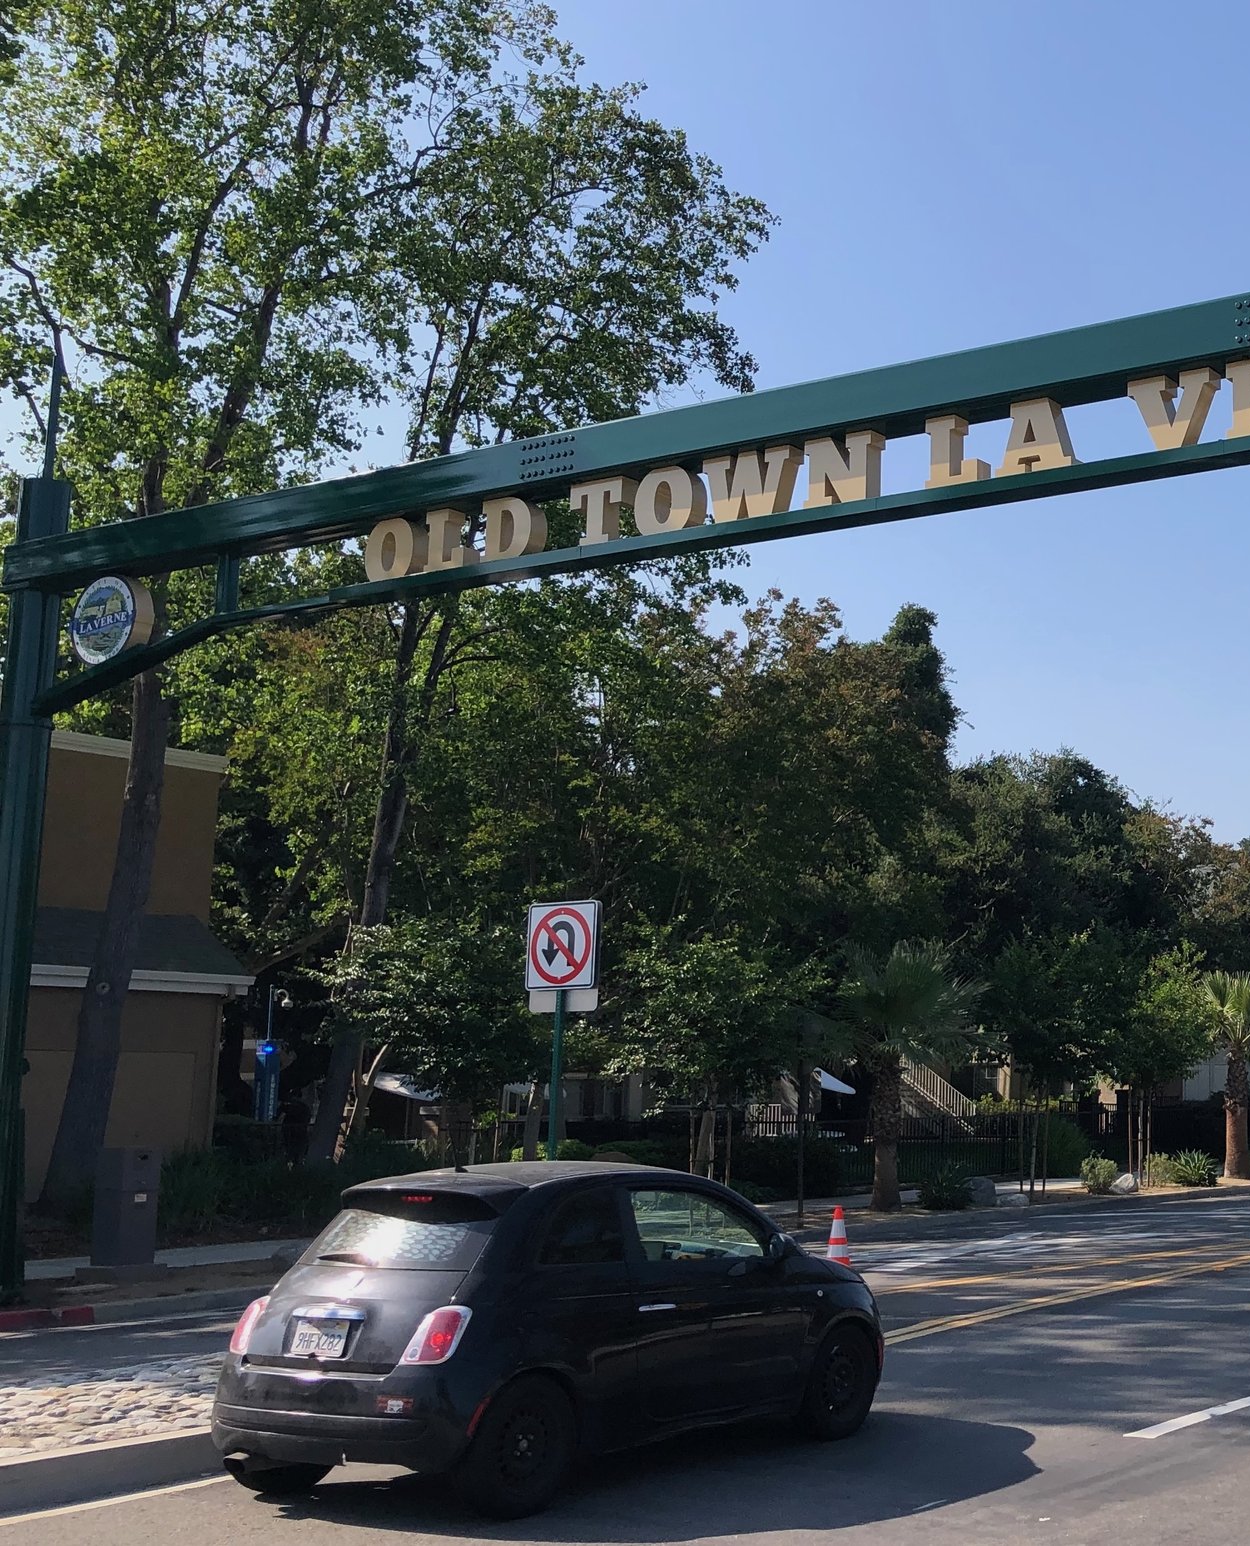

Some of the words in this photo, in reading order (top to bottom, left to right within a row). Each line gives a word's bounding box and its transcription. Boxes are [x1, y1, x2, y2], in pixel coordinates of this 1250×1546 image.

[364, 496, 545, 584] OLD
[570, 429, 884, 547] TOWN
[923, 396, 1080, 490] LA
[80, 622, 94, 635] LA
[94, 611, 128, 630] VERNE
[296, 1332, 342, 1351] 9HFX282
